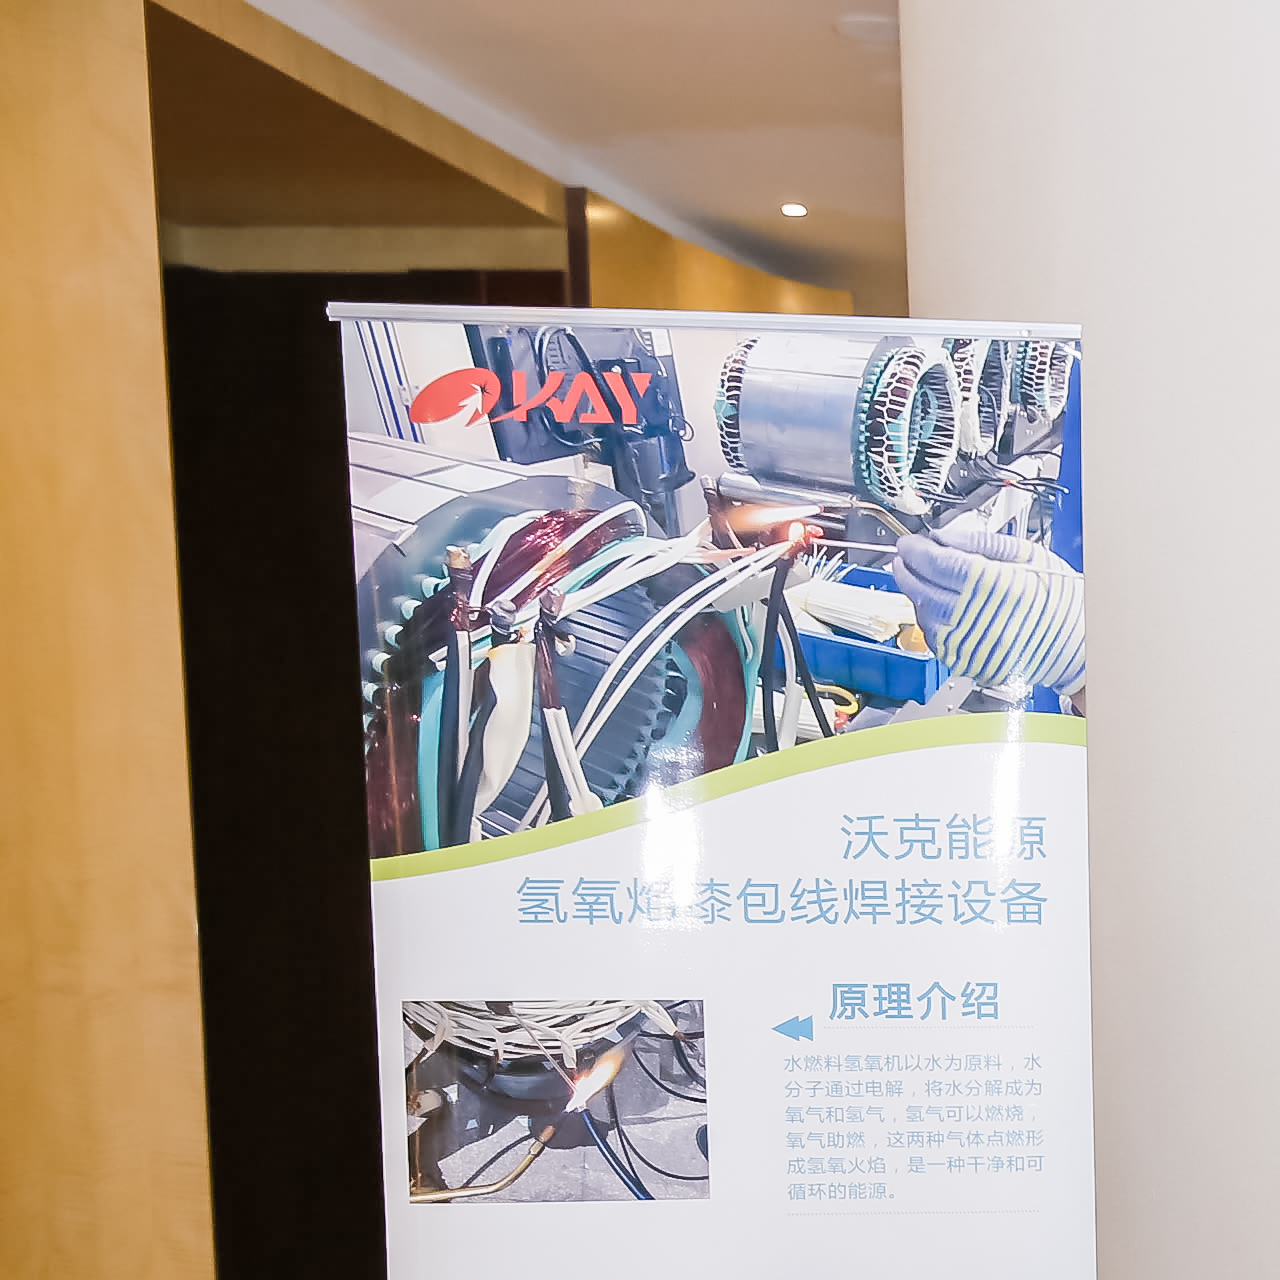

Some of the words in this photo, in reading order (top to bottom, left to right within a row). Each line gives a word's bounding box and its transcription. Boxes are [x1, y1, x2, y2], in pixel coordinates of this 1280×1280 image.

[840, 812, 1049, 861] 沃克能源
[828, 981, 1001, 1022] 原理介绍
[787, 1182, 898, 1200] 循环的能源。
